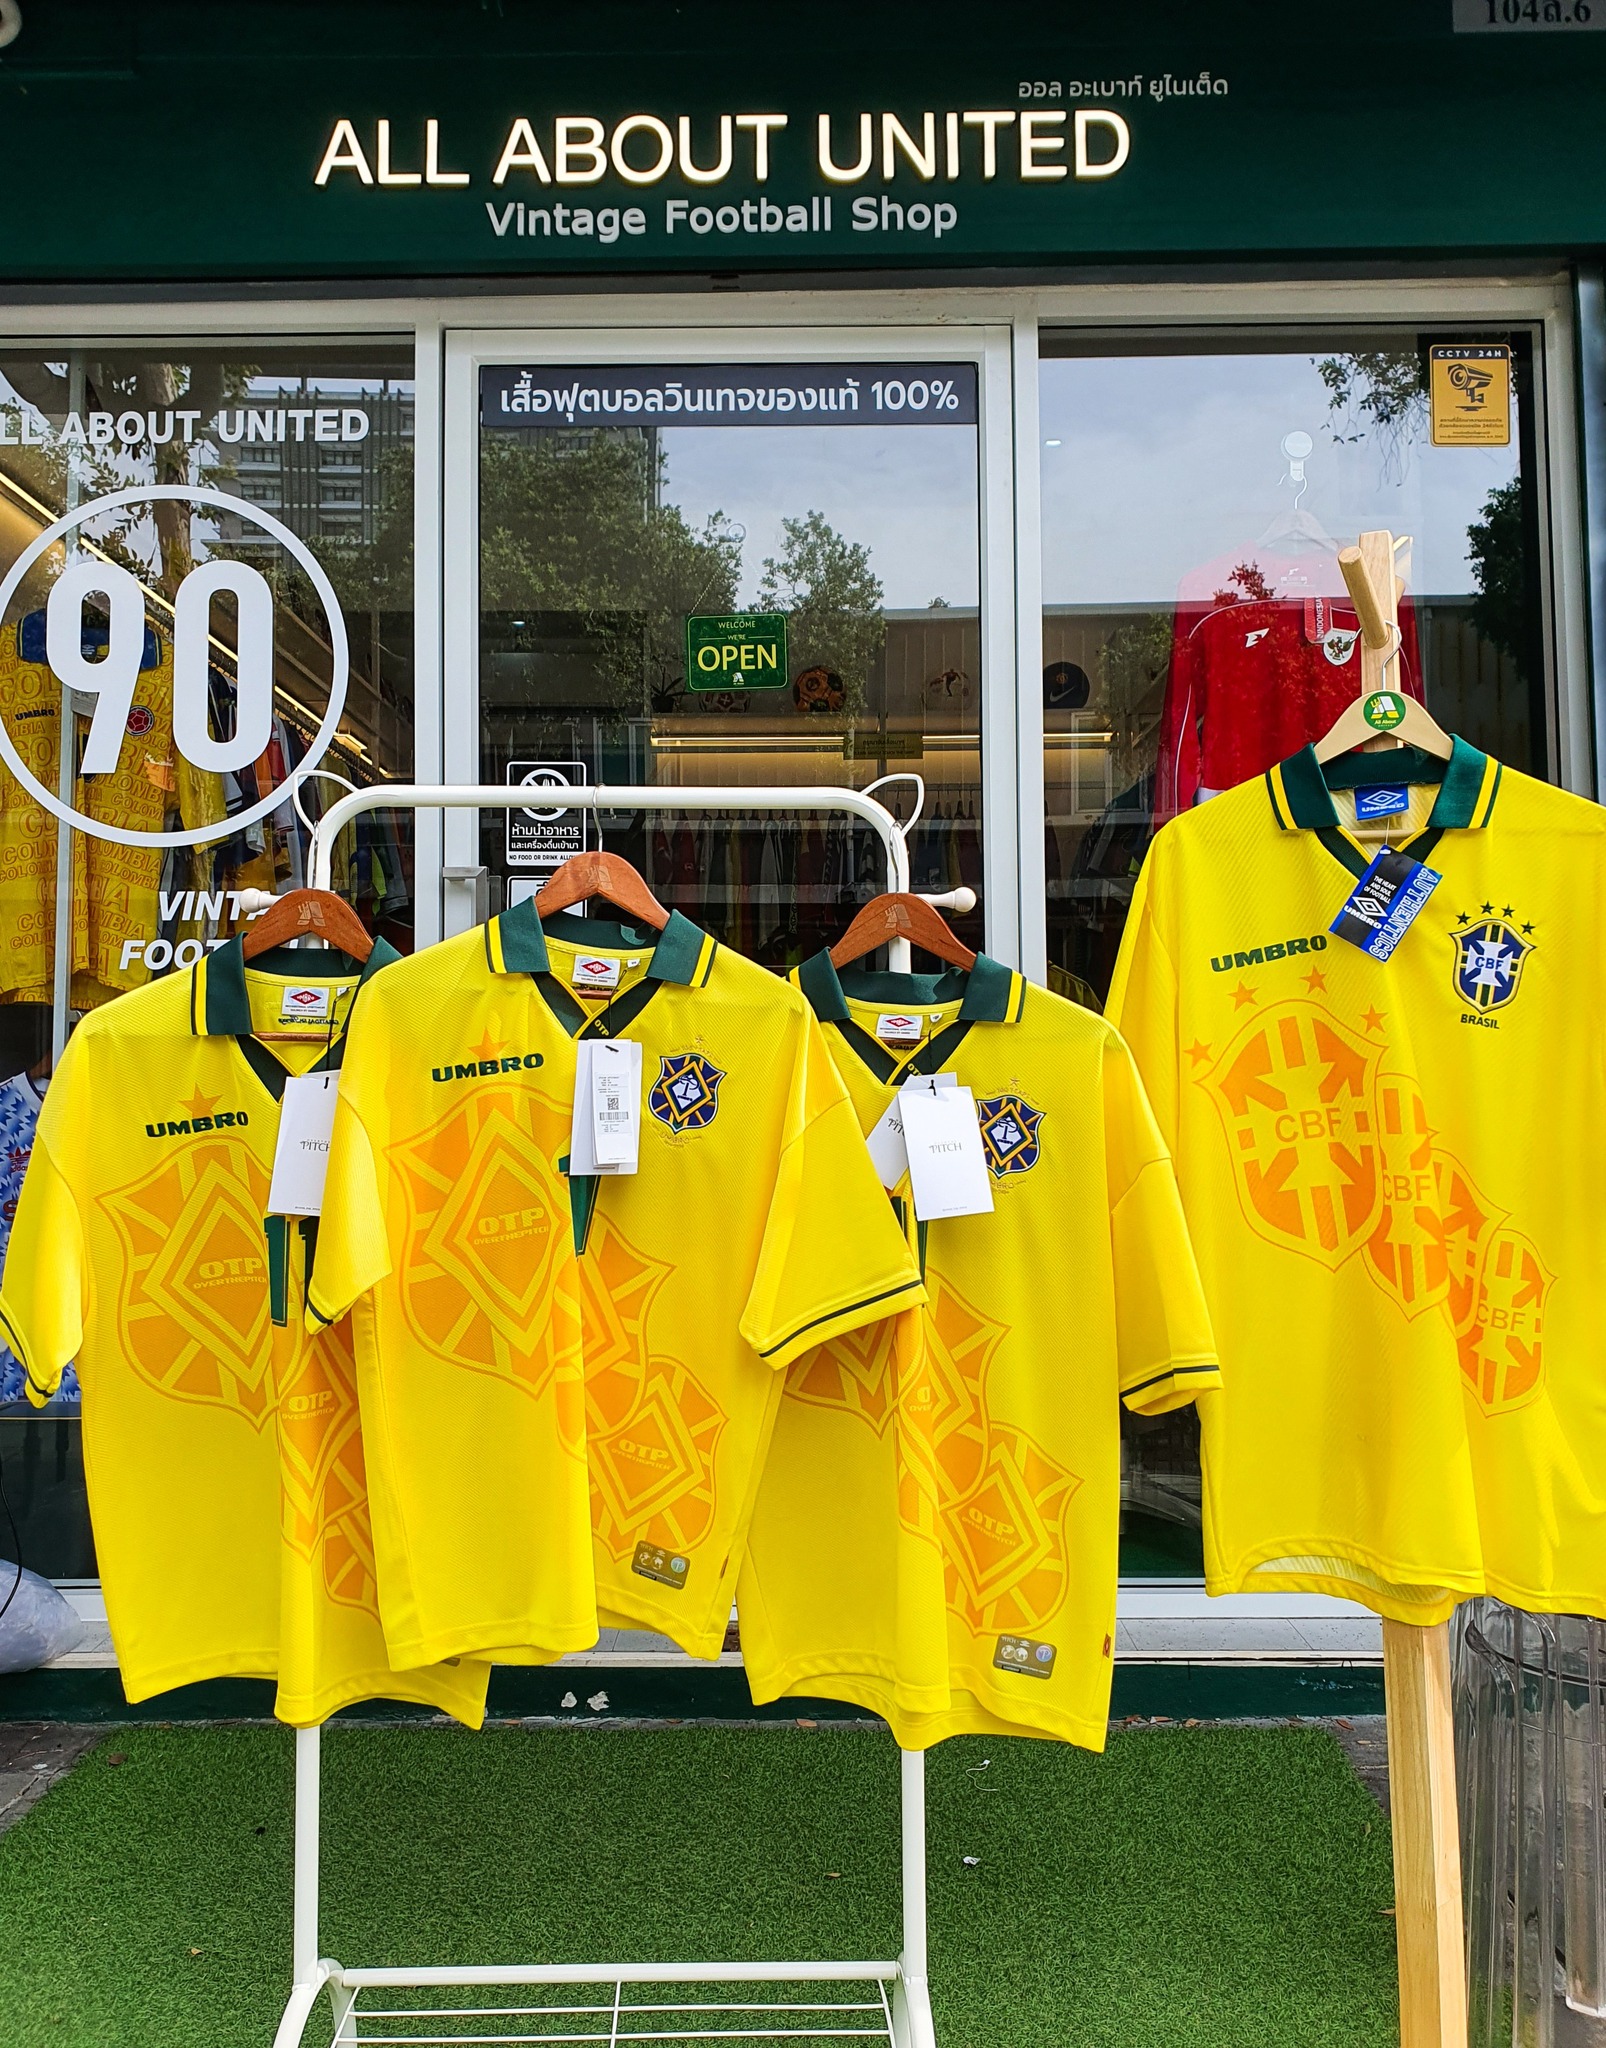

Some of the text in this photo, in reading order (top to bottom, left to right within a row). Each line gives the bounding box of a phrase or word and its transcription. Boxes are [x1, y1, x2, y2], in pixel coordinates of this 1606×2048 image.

[1017, 71, 1230, 103] ออล อะเบาท์ ยูไนเต็ด
[314, 108, 1131, 186] ALL ABOUT UNITED
[484, 195, 958, 244] Vintage Football Shop
[1437, 350, 1502, 358] CCTV 24H
[501, 370, 960, 423] เสื้อฟุตบอลวินเทจของแท้ 100%
[59, 410, 202, 445] ABOUT
[217, 408, 371, 443] UNITED
[717, 620, 757, 629] WELCOME
[46, 559, 274, 774] 90
[697, 643, 778, 672] OPEN
[15, 708, 56, 721] UMBRO
[511, 823, 580, 836] ห้ามนำอาหาร
[1369, 887, 1392, 905] FOOTBALL
[1370, 882, 1392, 897] AND SOUL
[1374, 875, 1398, 892] THE HEART
[1343, 905, 1383, 930] UMBRO
[1368, 867, 1439, 960] AUTHENTICS
[1210, 934, 1328, 973] UMBRO
[1474, 956, 1505, 971] CBF
[594, 1018, 611, 1037] OTP
[1460, 1013, 1501, 1030] BRASIL
[431, 1052, 545, 1083] UMBRO
[145, 1111, 250, 1139] UMBRO
[1274, 1107, 1342, 1144] CBF
[928, 1142, 963, 1154] PITCH
[1382, 1173, 1431, 1202] CBF
[477, 1206, 545, 1236] OTP
[199, 1257, 263, 1279] OTP
[1476, 1302, 1526, 1333] CBF
[288, 1390, 333, 1413] OTP
[618, 1438, 670, 1461] OTP
[968, 1507, 1016, 1536] OTP
